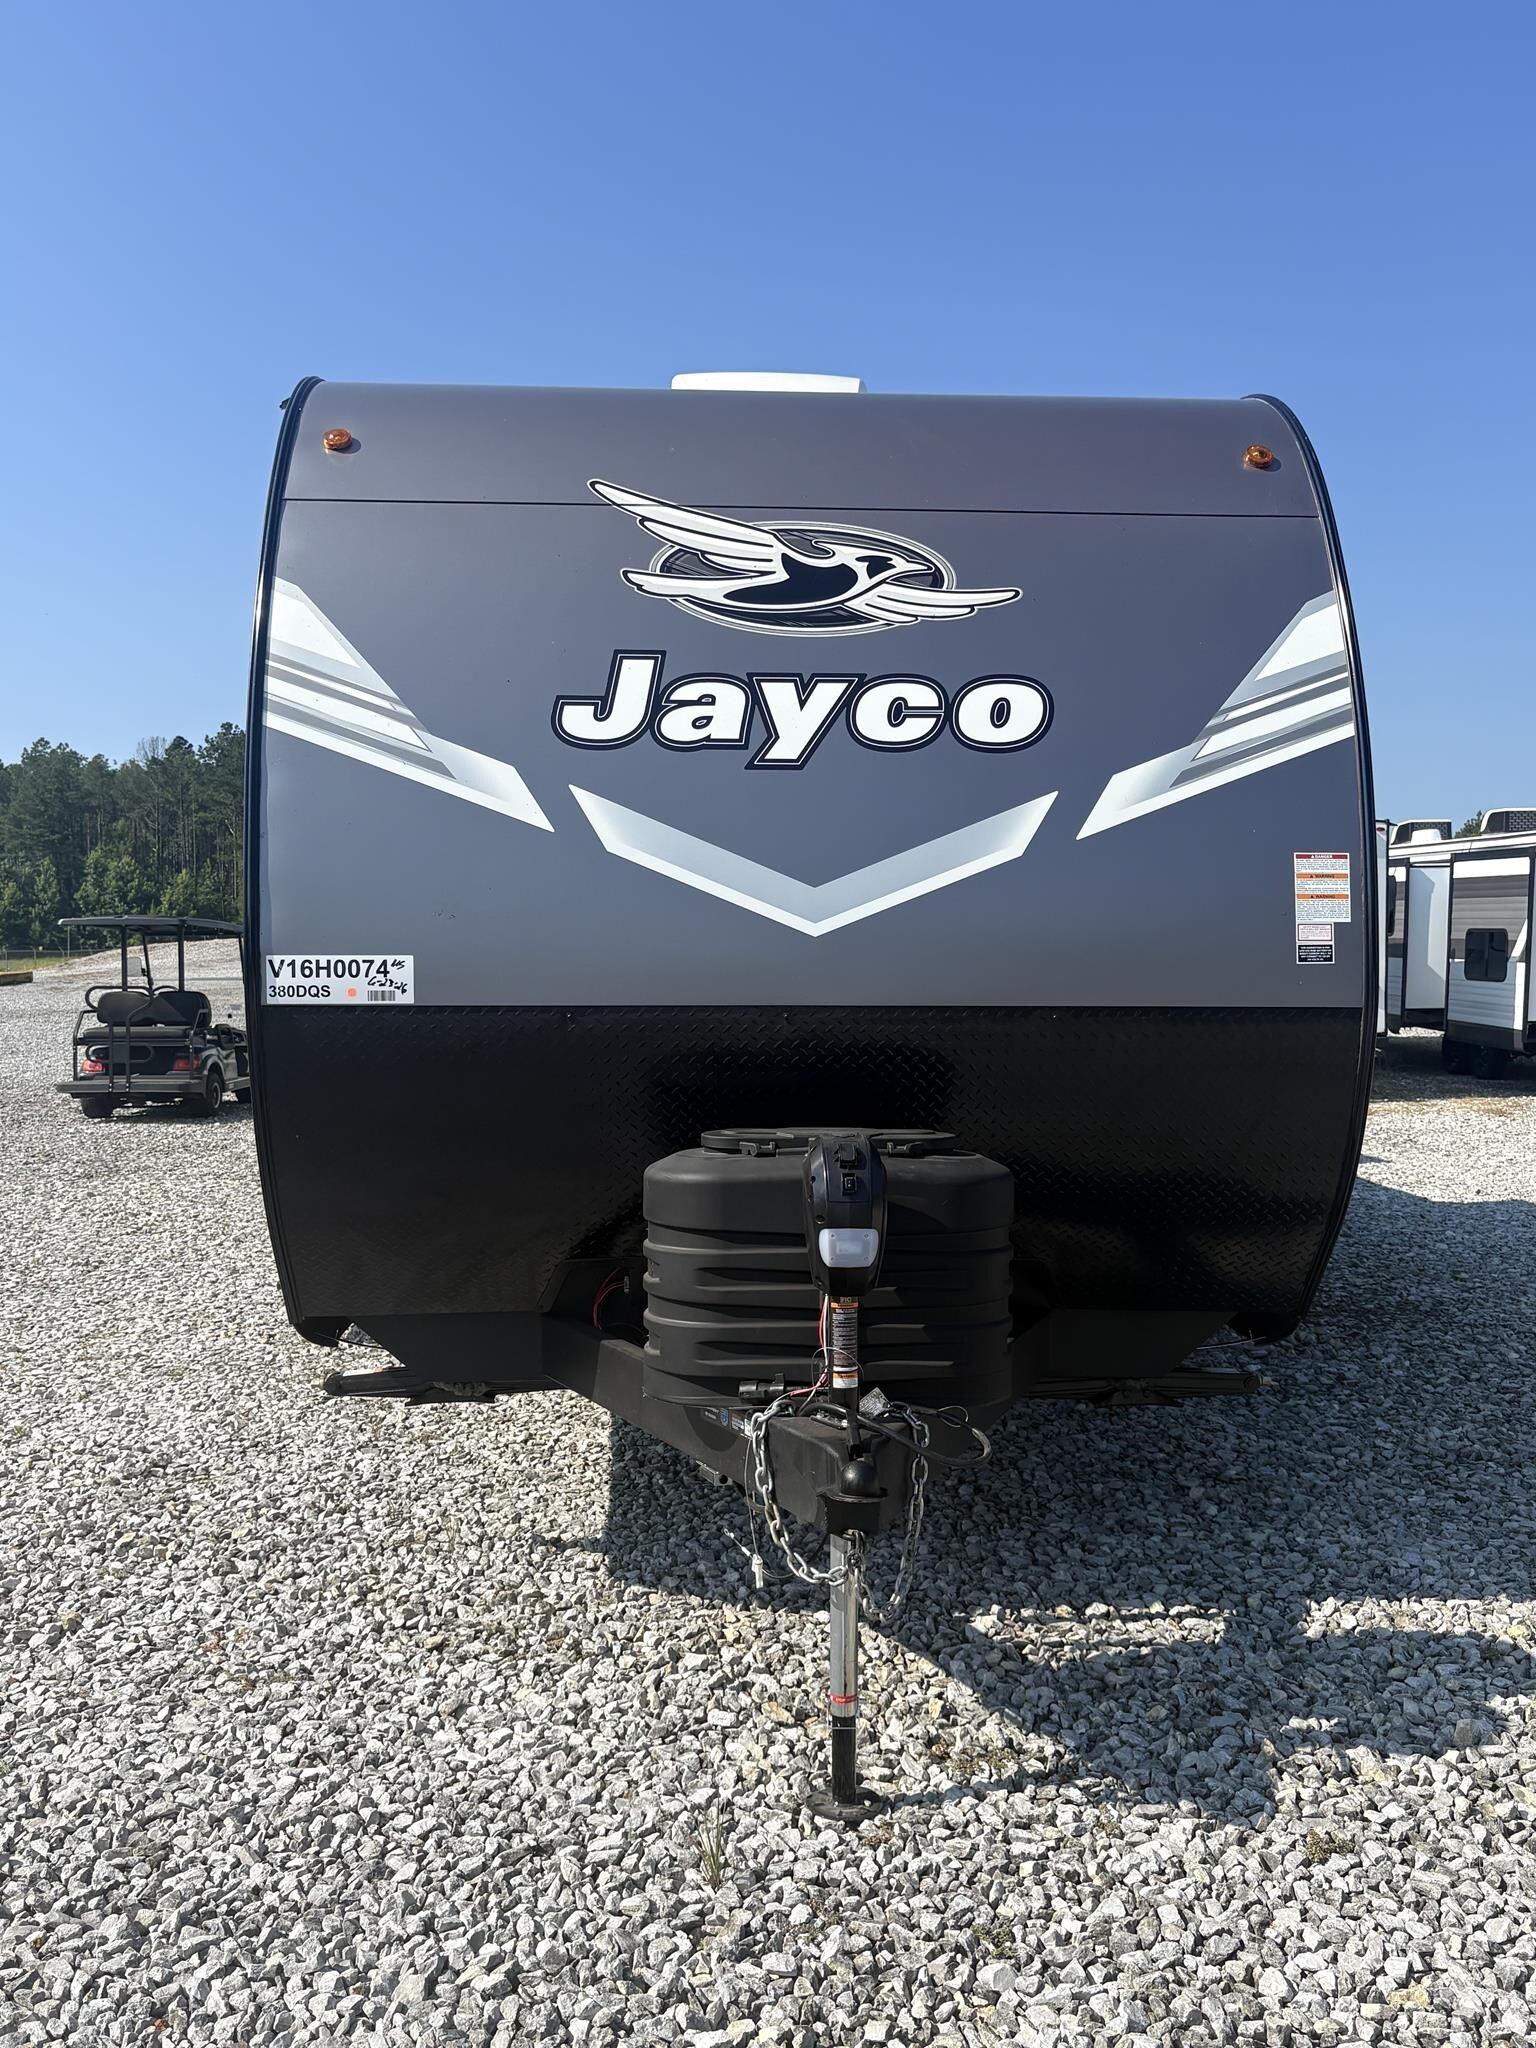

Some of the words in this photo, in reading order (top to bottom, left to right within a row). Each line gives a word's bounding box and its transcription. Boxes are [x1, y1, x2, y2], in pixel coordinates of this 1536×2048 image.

[552, 649, 1054, 770] Jayco
[267, 959, 389, 978] V16H0074
[268, 985, 331, 998] 380DQS
